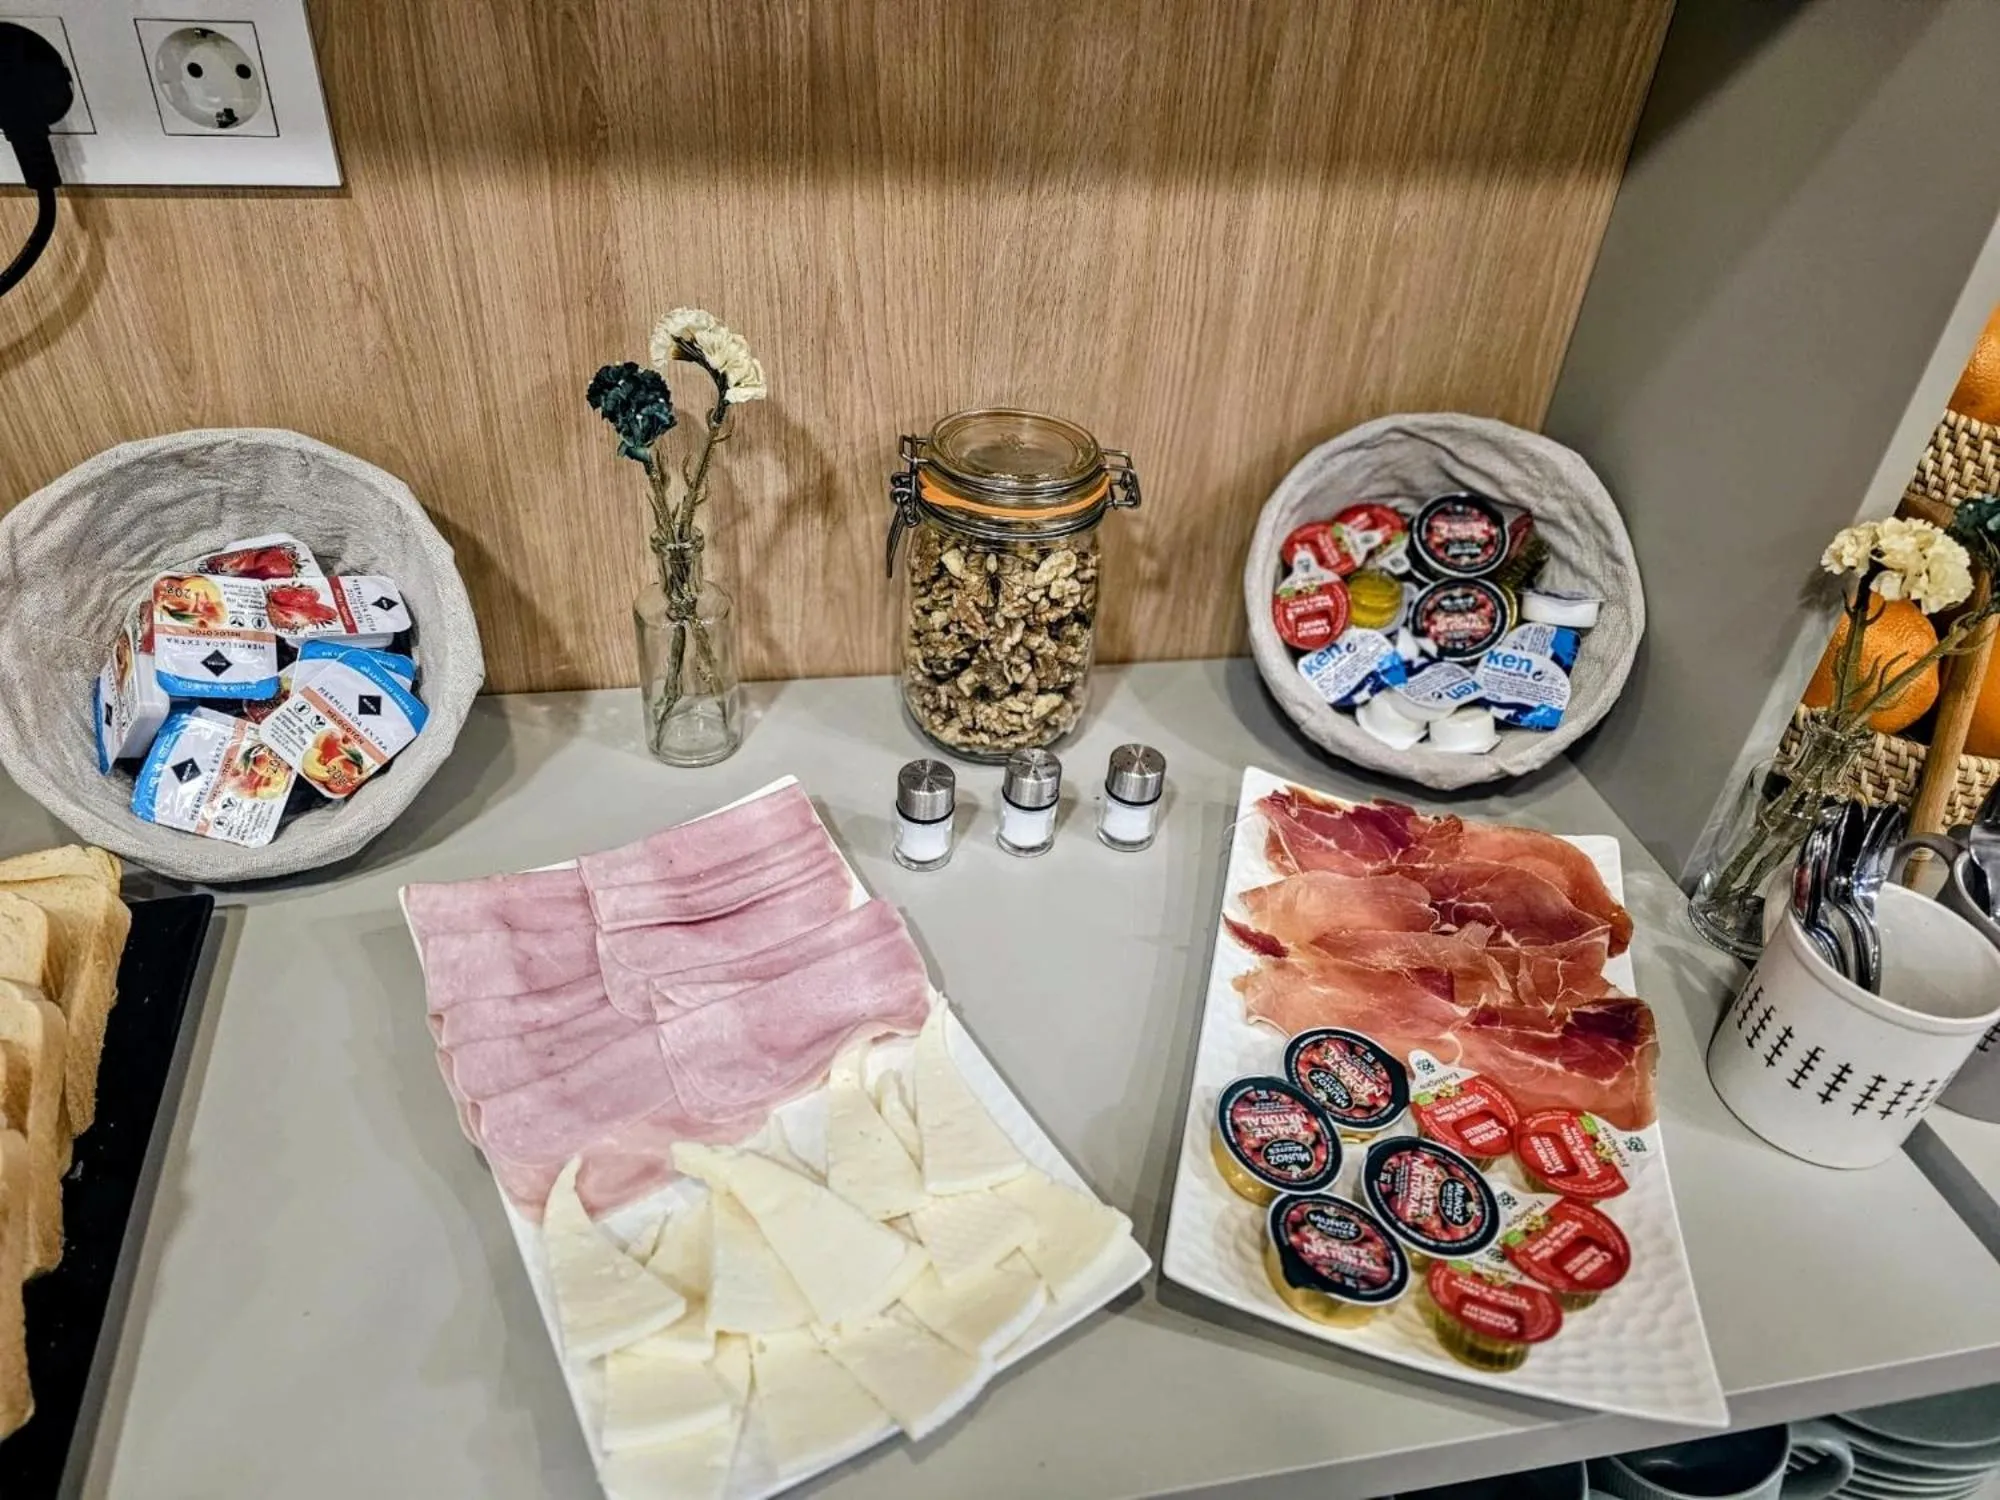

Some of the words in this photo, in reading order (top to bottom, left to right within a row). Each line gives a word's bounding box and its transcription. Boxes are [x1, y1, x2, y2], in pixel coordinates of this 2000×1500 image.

[166, 584, 191, 599] 20g
[165, 637, 199, 645] EXTRA
[205, 640, 264, 649] MERMELADA
[1303, 642, 1342, 676] ken
[1486, 651, 1532, 673] ken
[1448, 680, 1481, 700] ken
[317, 685, 363, 727] MERMELADA
[362, 727, 388, 751] EXTRA
[189, 767, 216, 821] MERMELADA
[1326, 1044, 1384, 1097] NATURAL
[1237, 1113, 1307, 1124] NATURAL
[1253, 1124, 1306, 1137] TOMATE
[1267, 1151, 1309, 1164] MUÑOZ
[1529, 1135, 1555, 1174] CAPRICHO
[1540, 1136, 1566, 1173] ANDALUZ
[1408, 1157, 1423, 1217] NATURAL
